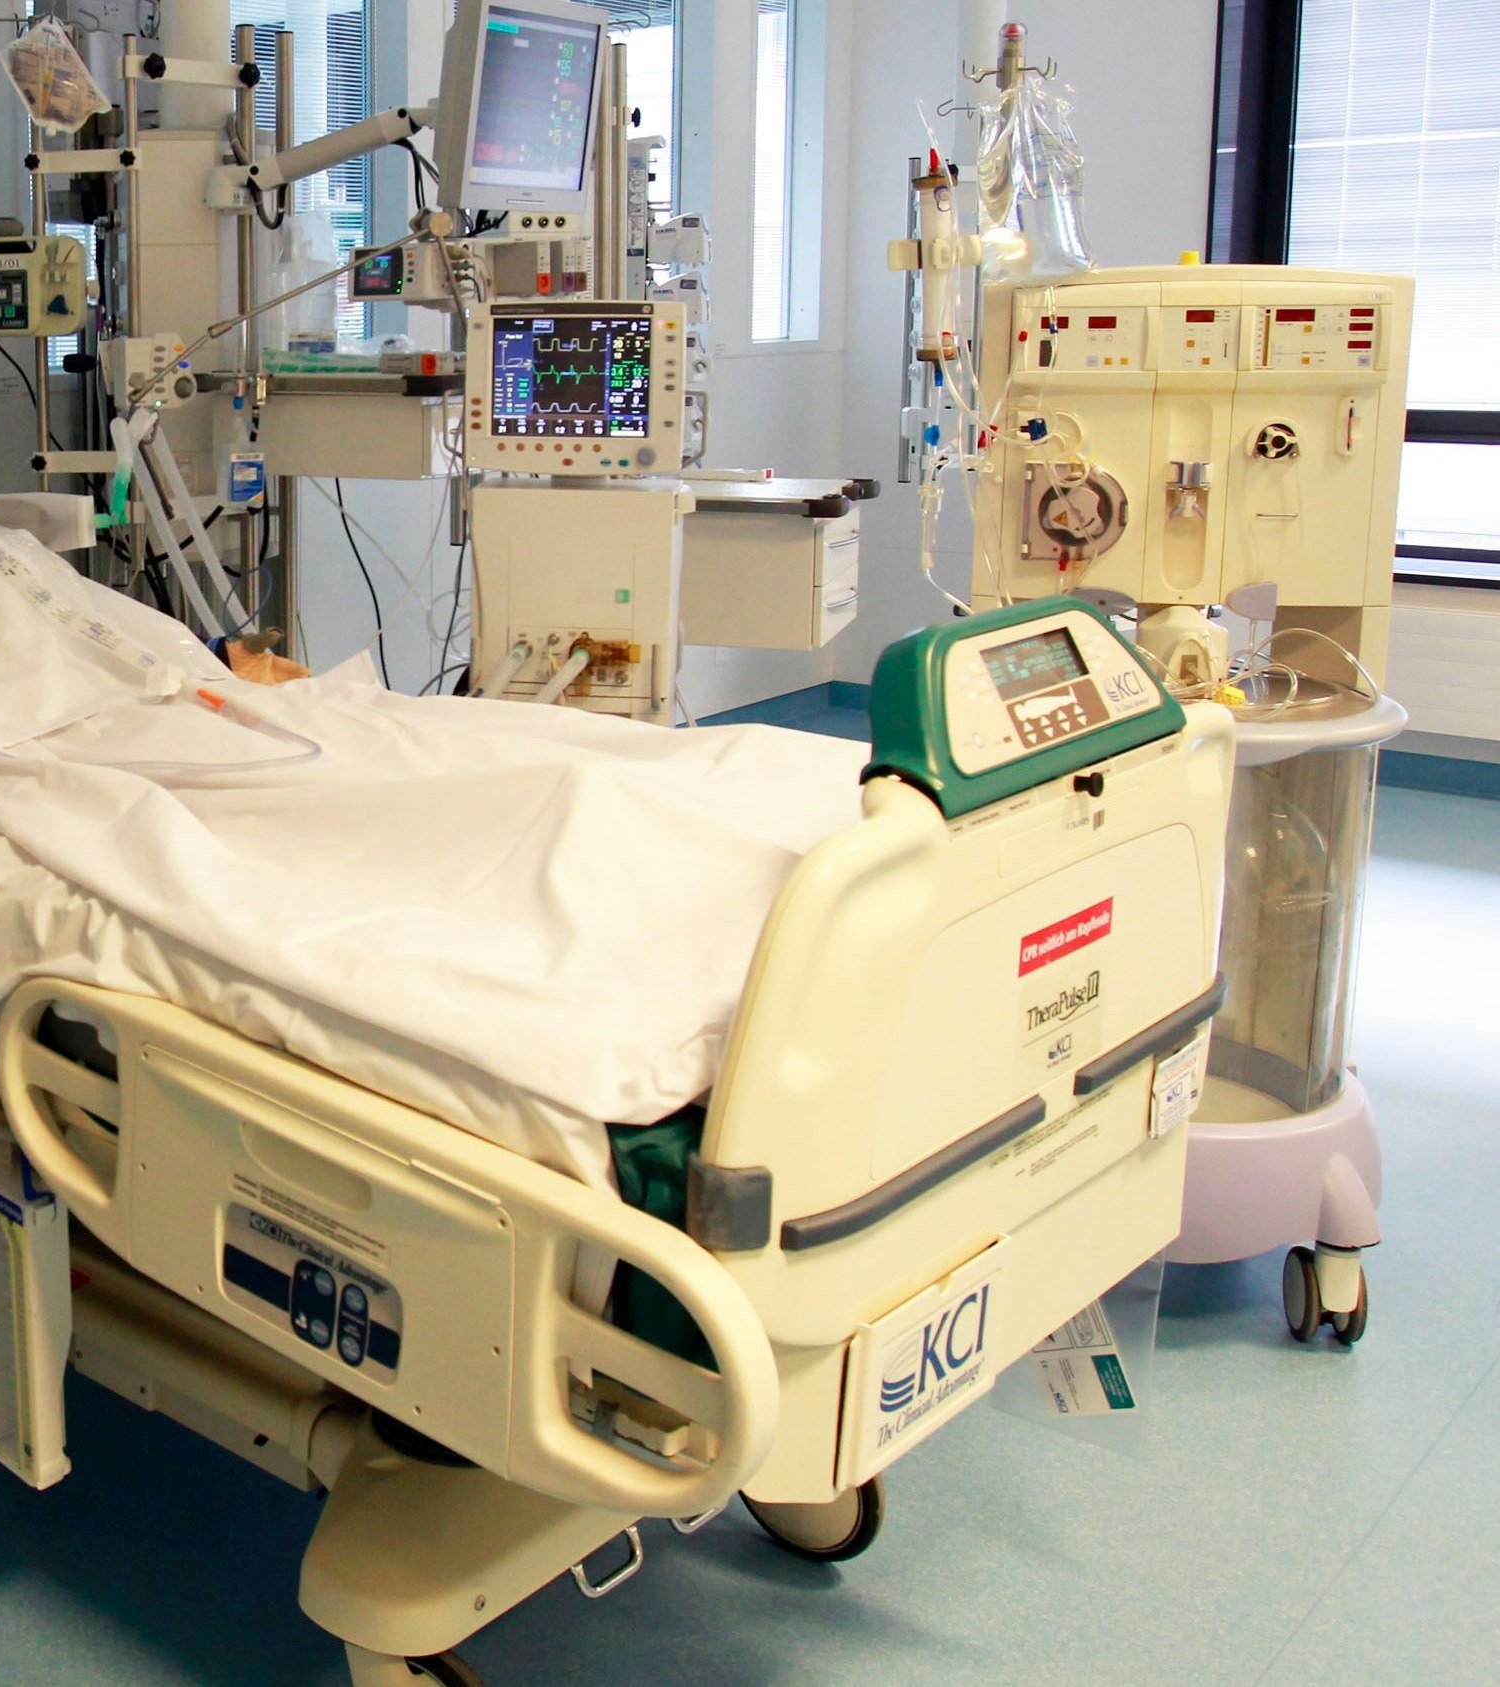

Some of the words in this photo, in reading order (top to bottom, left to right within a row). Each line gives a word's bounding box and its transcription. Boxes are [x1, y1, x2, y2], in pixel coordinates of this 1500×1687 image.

[1113, 671, 1143, 698] KCI
[1022, 944, 1038, 963] CPR
[1065, 928, 1077, 943] am
[1027, 982, 1088, 1030] TheraPulse
[917, 1283, 990, 1396] KCI
[877, 1421, 894, 1448] The
[895, 1389, 934, 1433] Clinical
[937, 1362, 982, 1404] Advantage
